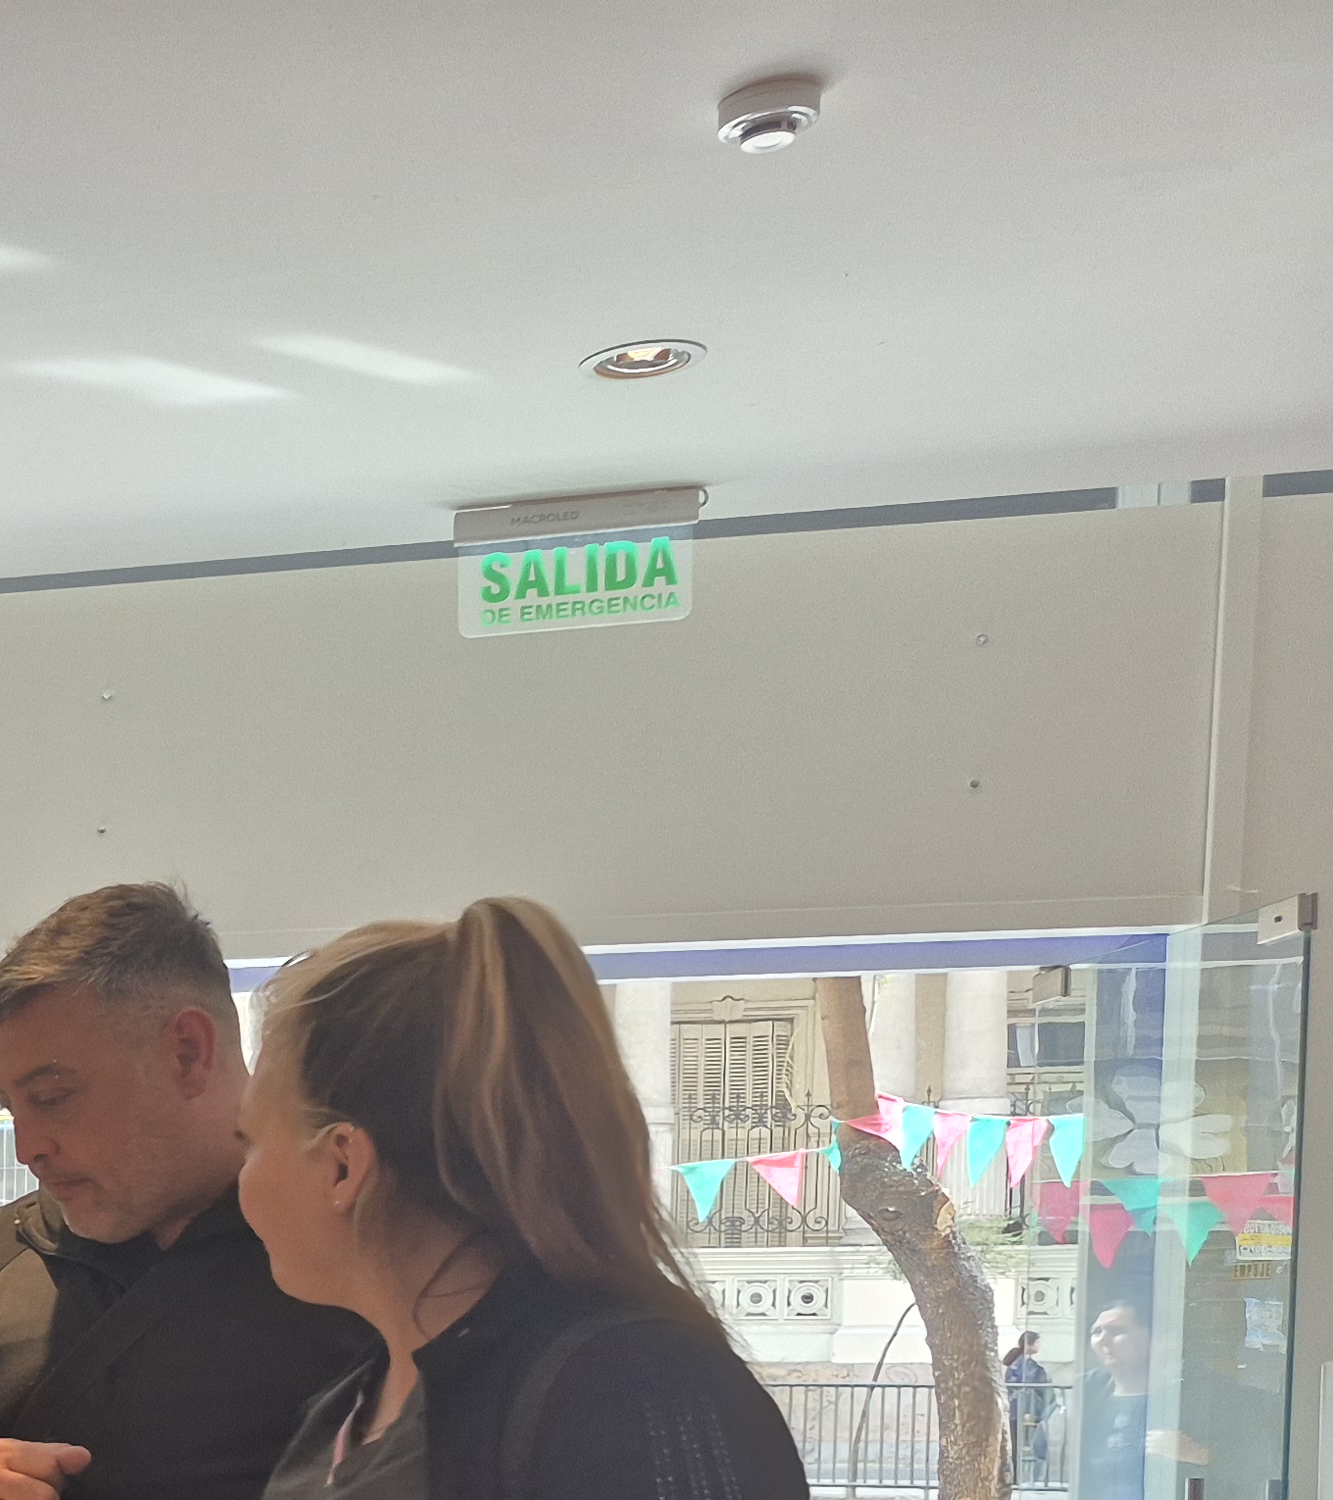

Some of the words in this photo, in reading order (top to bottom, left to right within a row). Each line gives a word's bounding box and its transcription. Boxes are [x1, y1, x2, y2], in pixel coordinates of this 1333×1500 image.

[480, 536, 679, 603] SALIDA
[480, 605, 513, 628] DE
[519, 591, 681, 623] EMERGENCIA
